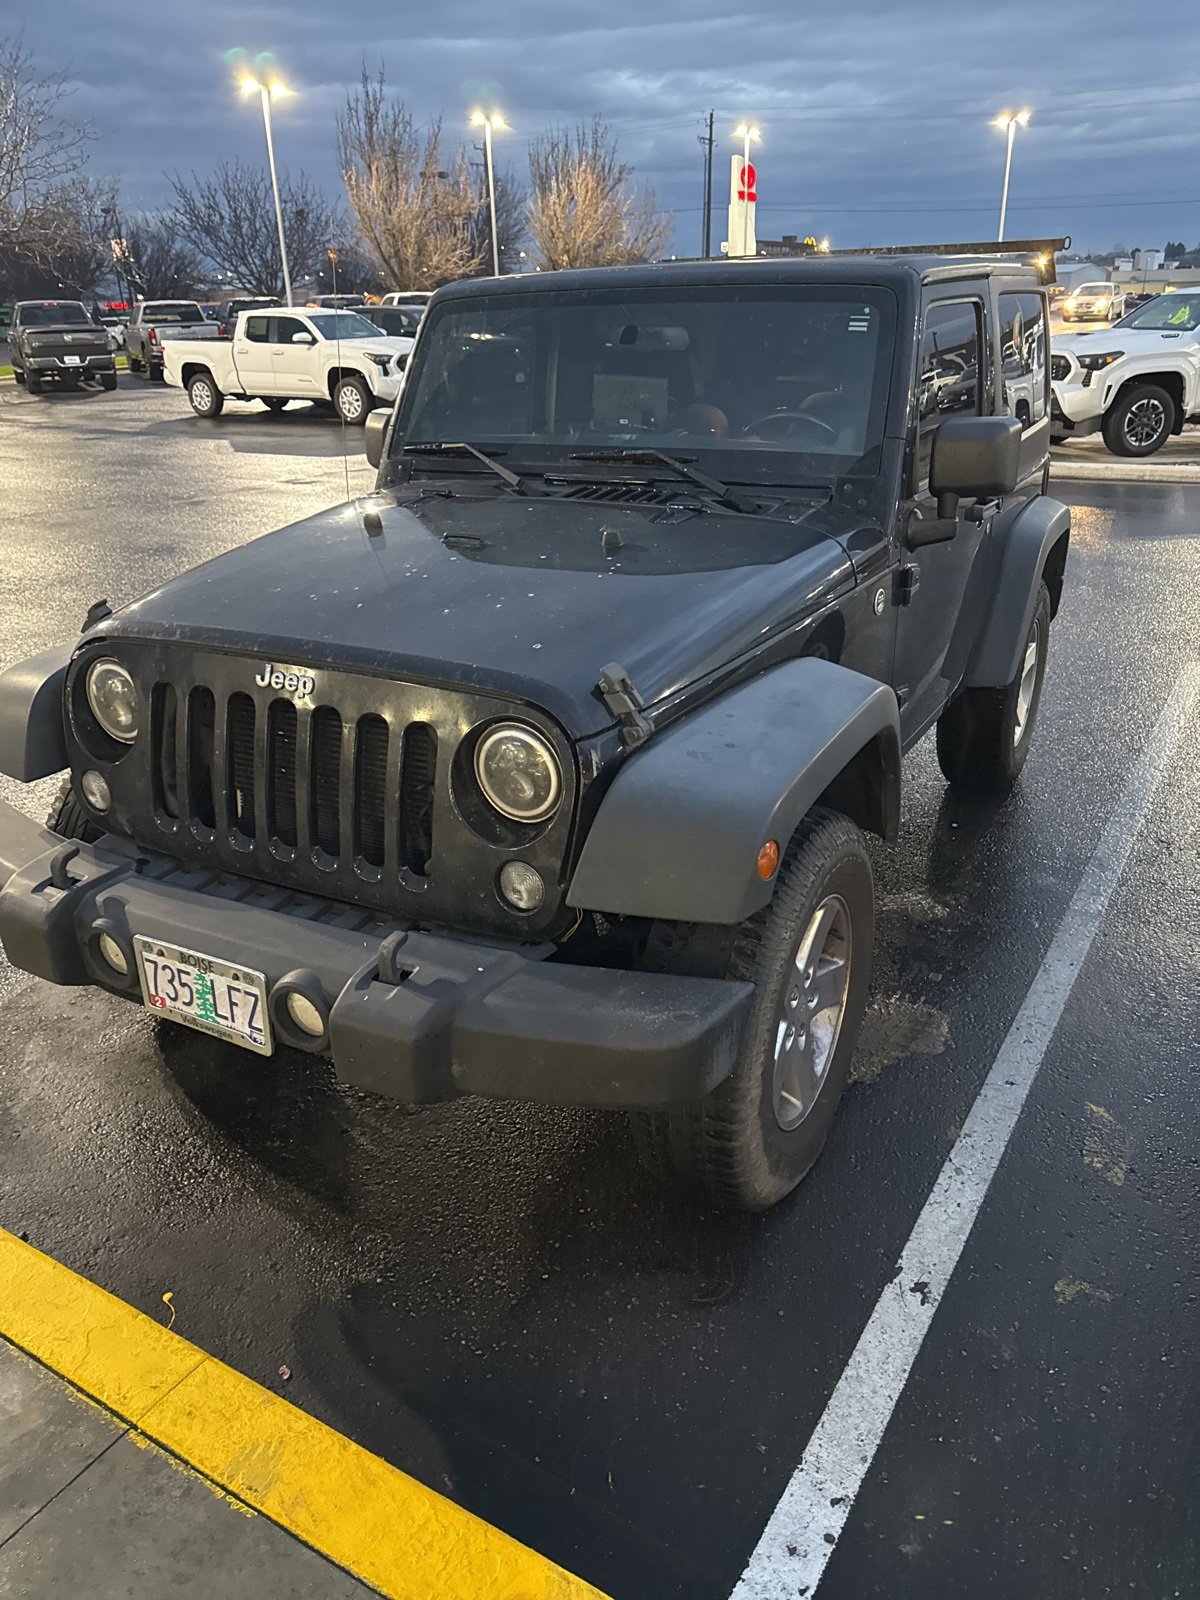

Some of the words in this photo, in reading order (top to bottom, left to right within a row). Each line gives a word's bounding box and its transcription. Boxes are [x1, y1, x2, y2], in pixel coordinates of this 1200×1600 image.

[255, 663, 315, 699] Jeep
[179, 951, 215, 975] BOISE
[144, 958, 195, 1007] 735
[209, 978, 264, 1034] LFZ
[180, 1013, 234, 1040] Volkswagen
